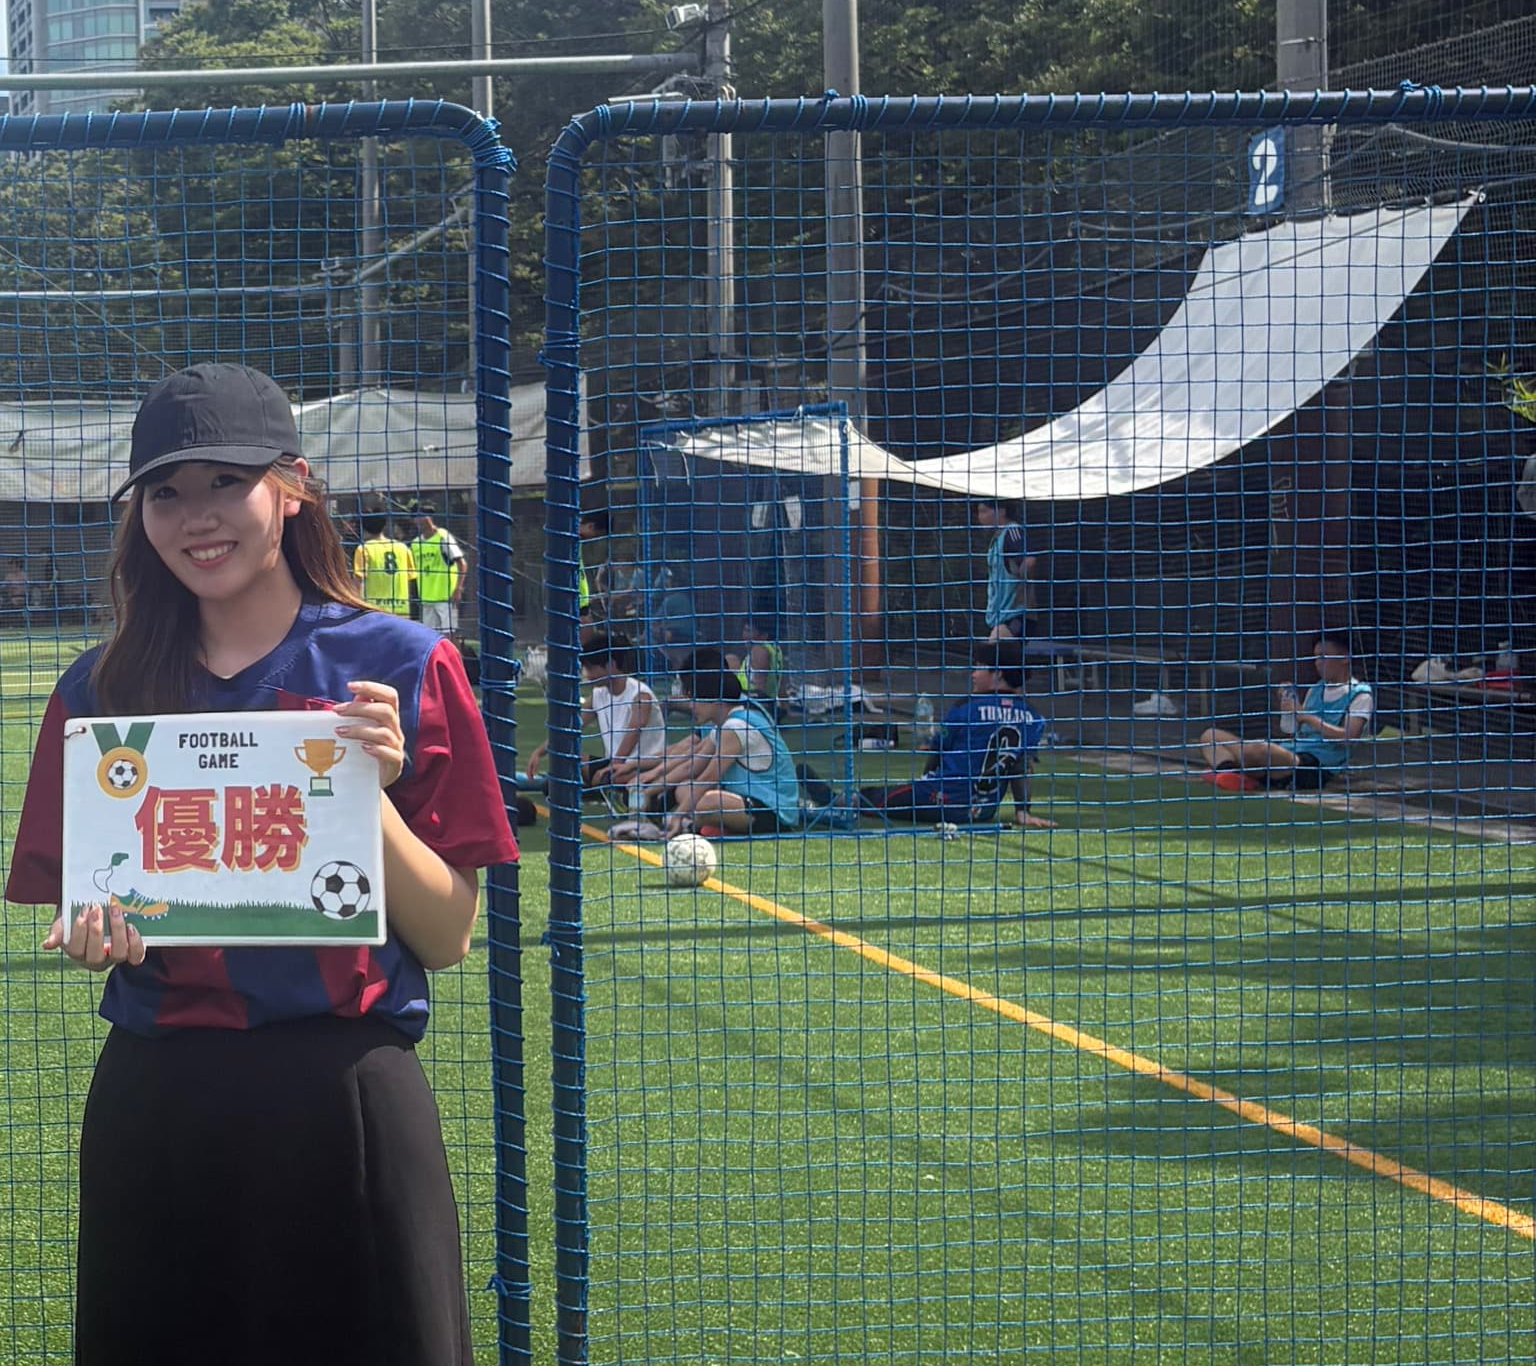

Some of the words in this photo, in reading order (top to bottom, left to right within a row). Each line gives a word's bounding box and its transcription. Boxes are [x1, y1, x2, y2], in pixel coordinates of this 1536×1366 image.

[1252, 138, 1278, 206] 2
[384, 551, 399, 575] 8
[978, 705, 1034, 725] THAILAND
[179, 731, 259, 749] FOOTBALL
[198, 753, 239, 769] GAME
[135, 783, 309, 873] 優勝
